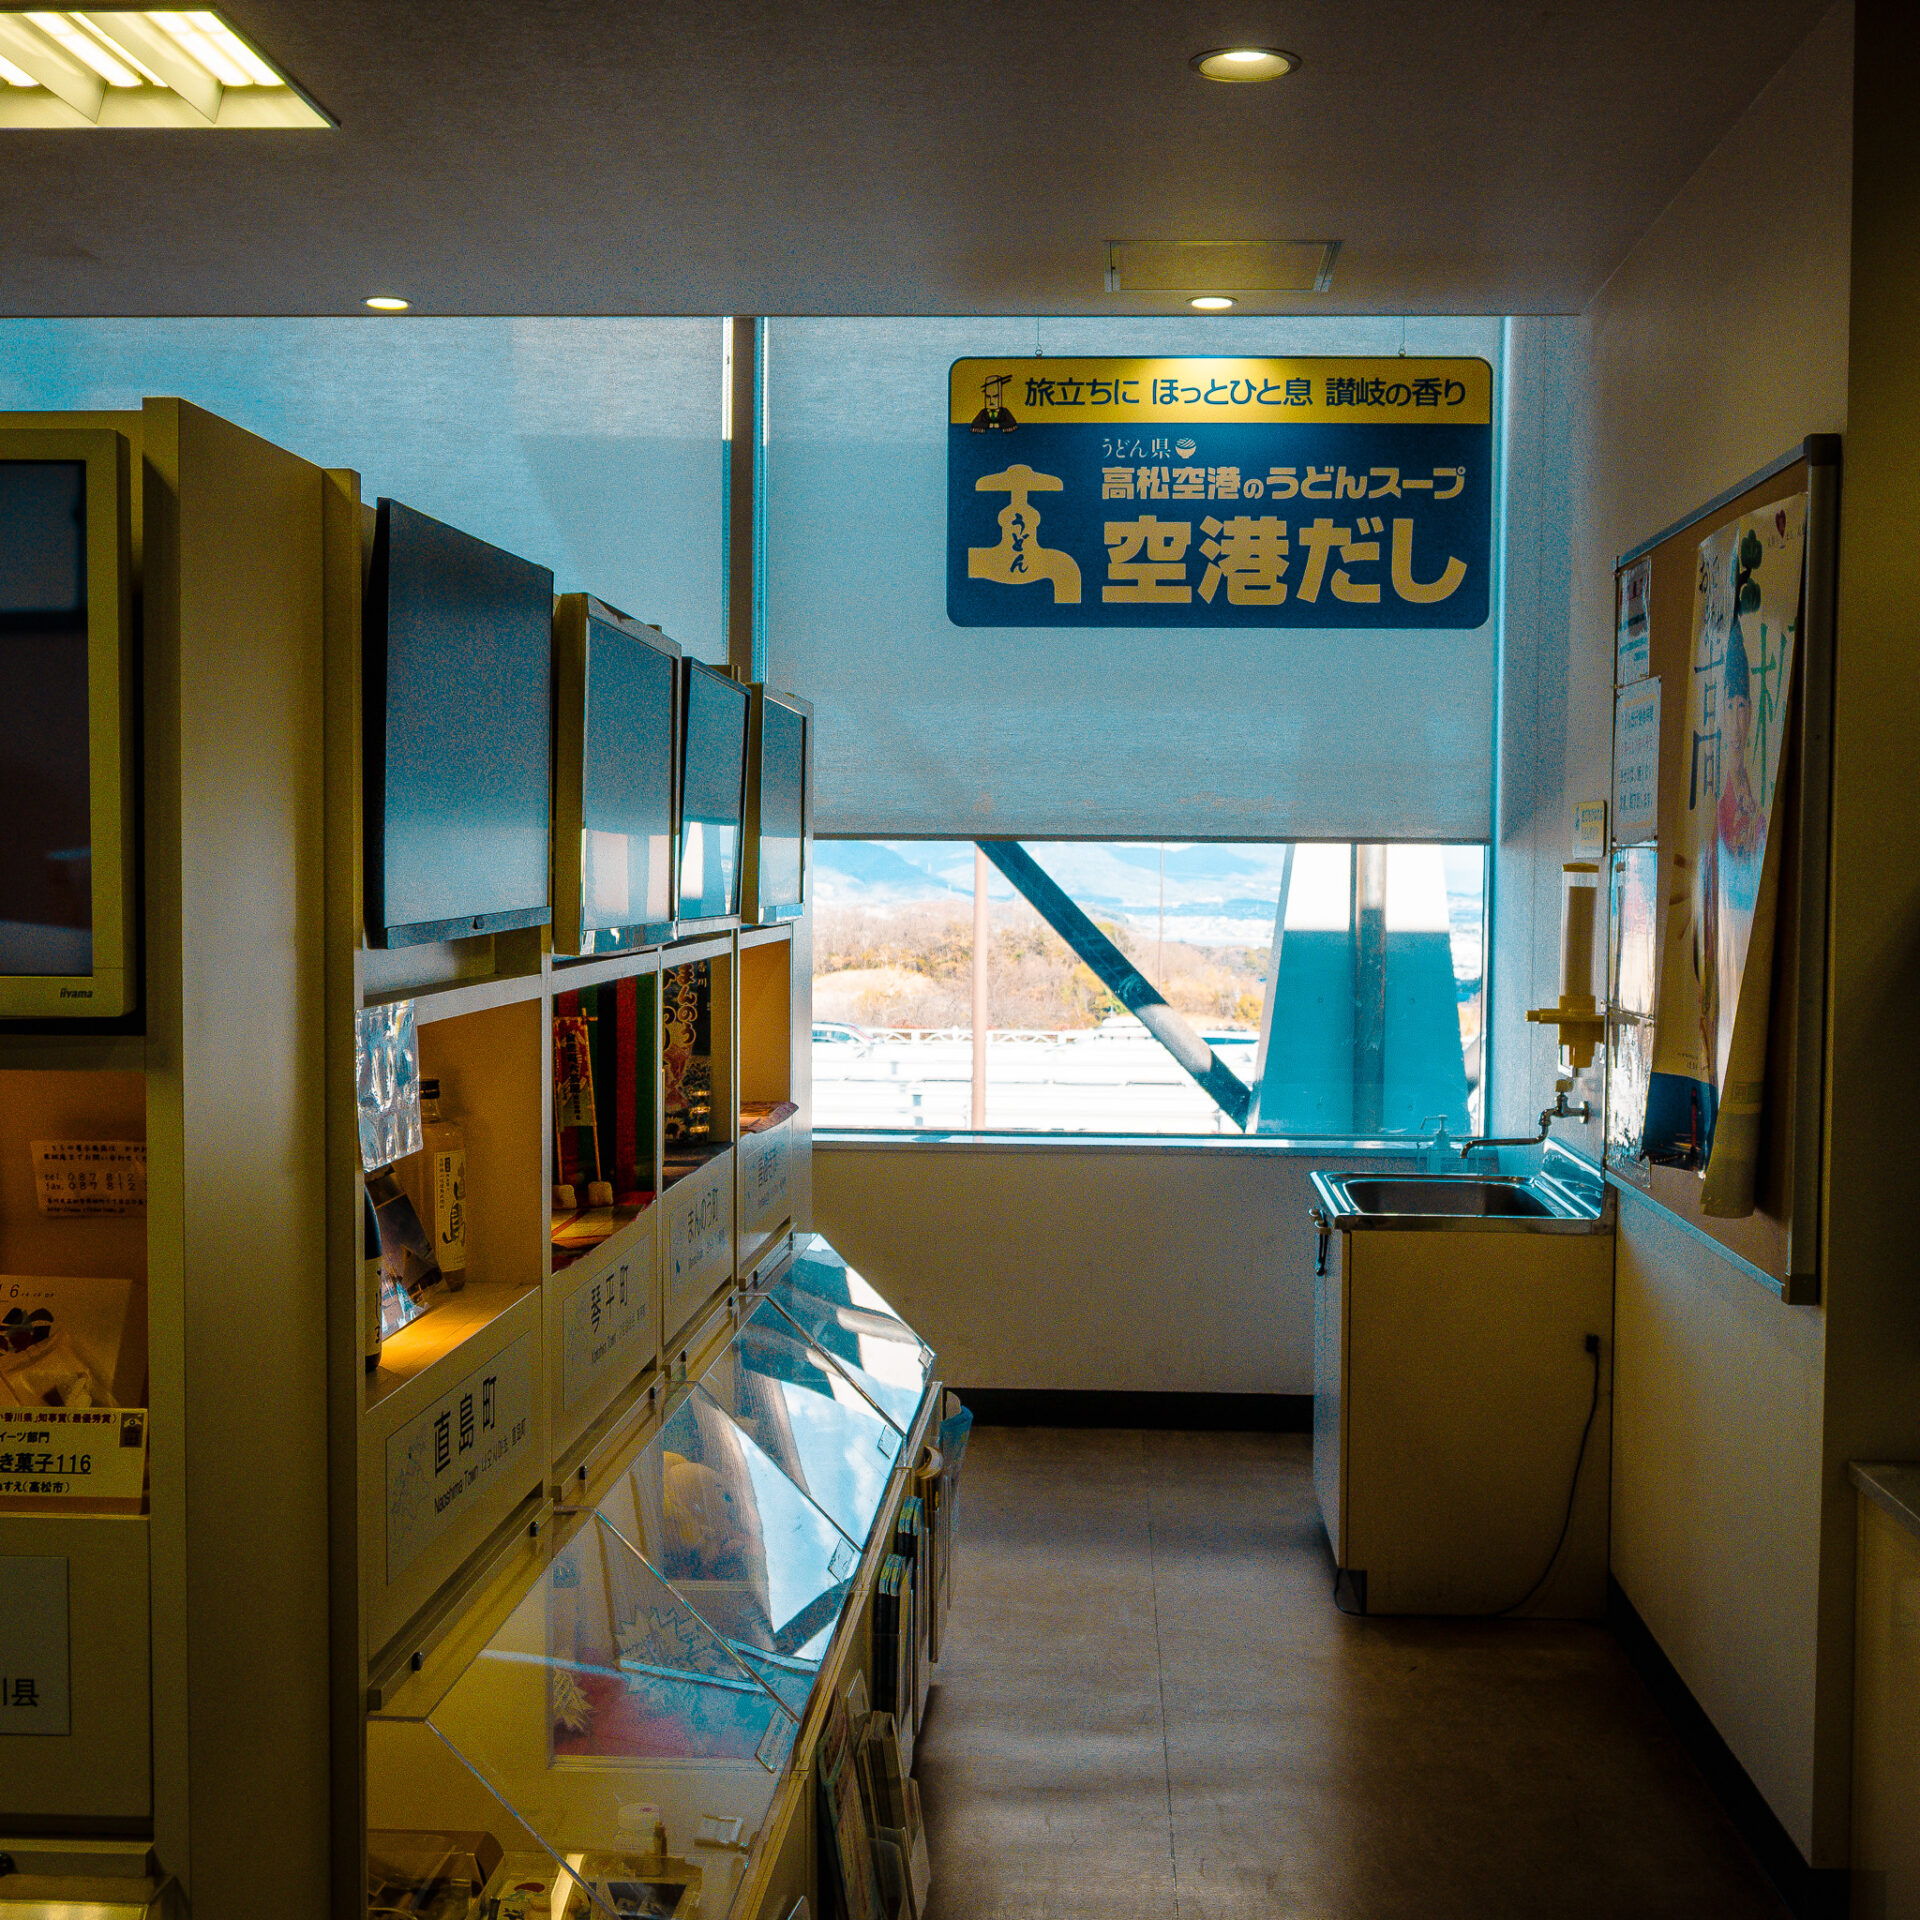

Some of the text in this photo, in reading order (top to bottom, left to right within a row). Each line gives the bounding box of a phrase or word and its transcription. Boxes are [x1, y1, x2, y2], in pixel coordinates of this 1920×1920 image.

[1024, 376, 1467, 408] 旅立ちに ほっとひと息 讃岐の香り
[1101, 438, 1171, 459] うどん県
[1101, 465, 1466, 501] 高松空港のうどんスープ
[1010, 511, 1029, 574] うどん
[1101, 514, 1468, 606] 空港だし
[590, 1264, 629, 1334] 琴平町
[433, 1375, 497, 1478] 直島町
[0, 1481, 70, 1493] すえ(高松市)
